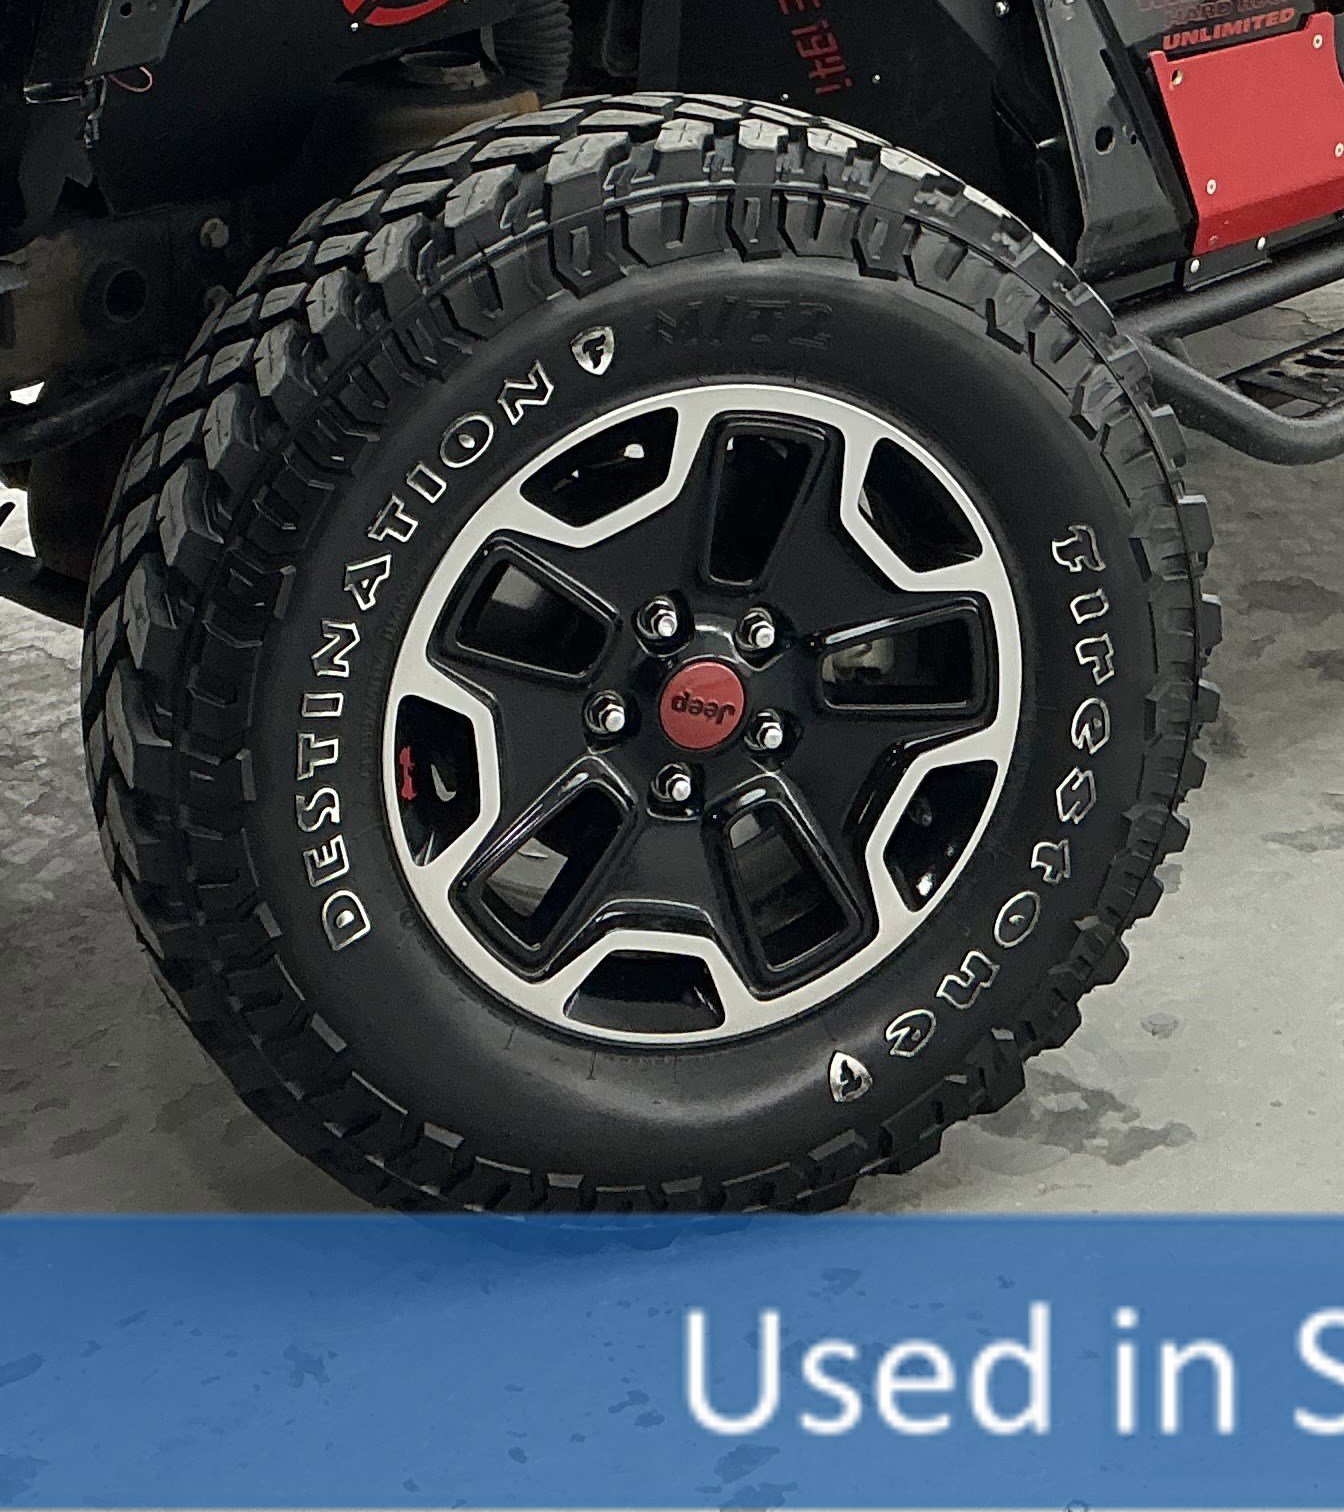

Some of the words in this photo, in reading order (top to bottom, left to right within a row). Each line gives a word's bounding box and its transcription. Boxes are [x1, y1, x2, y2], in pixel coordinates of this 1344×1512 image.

[791, 19, 854, 96] 1941
[1162, 8, 1296, 50] UNLIMITED
[295, 359, 555, 951] DESTINATION
[670, 690, 736, 725] Jeep
